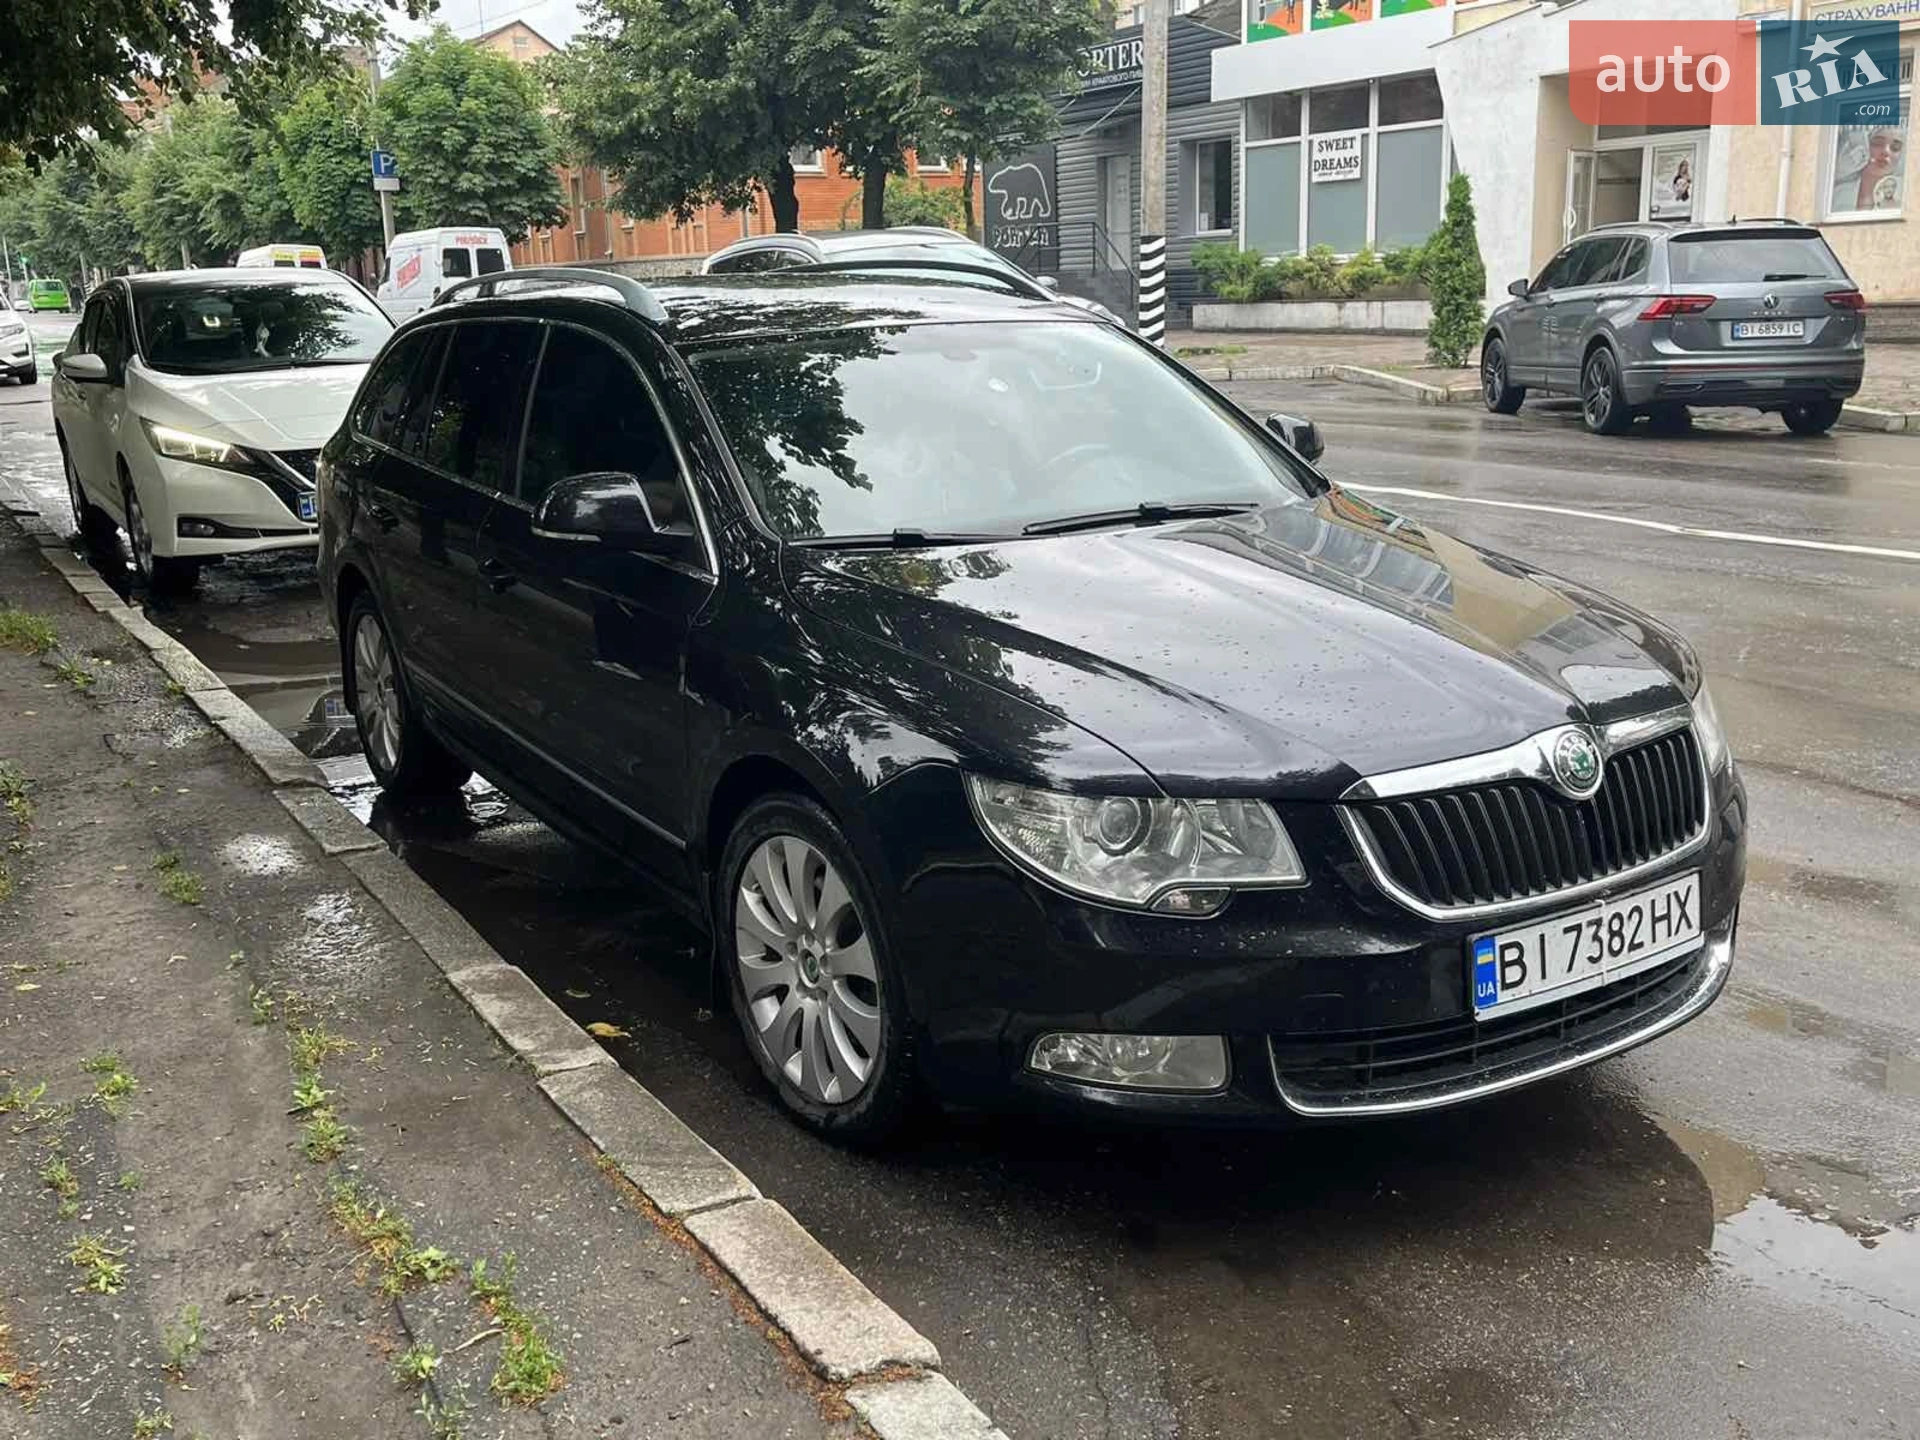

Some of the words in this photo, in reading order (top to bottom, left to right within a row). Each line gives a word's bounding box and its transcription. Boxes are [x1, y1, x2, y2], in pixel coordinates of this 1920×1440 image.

[1318, 136, 1356, 152] SWEET
[380, 153, 392, 174] P
[1313, 155, 1360, 172] DREAMS
[1499, 933, 1547, 992] BI
[1563, 905, 1645, 974] 7382
[1651, 885, 1693, 942] HX
[1478, 982, 1496, 998] UA
